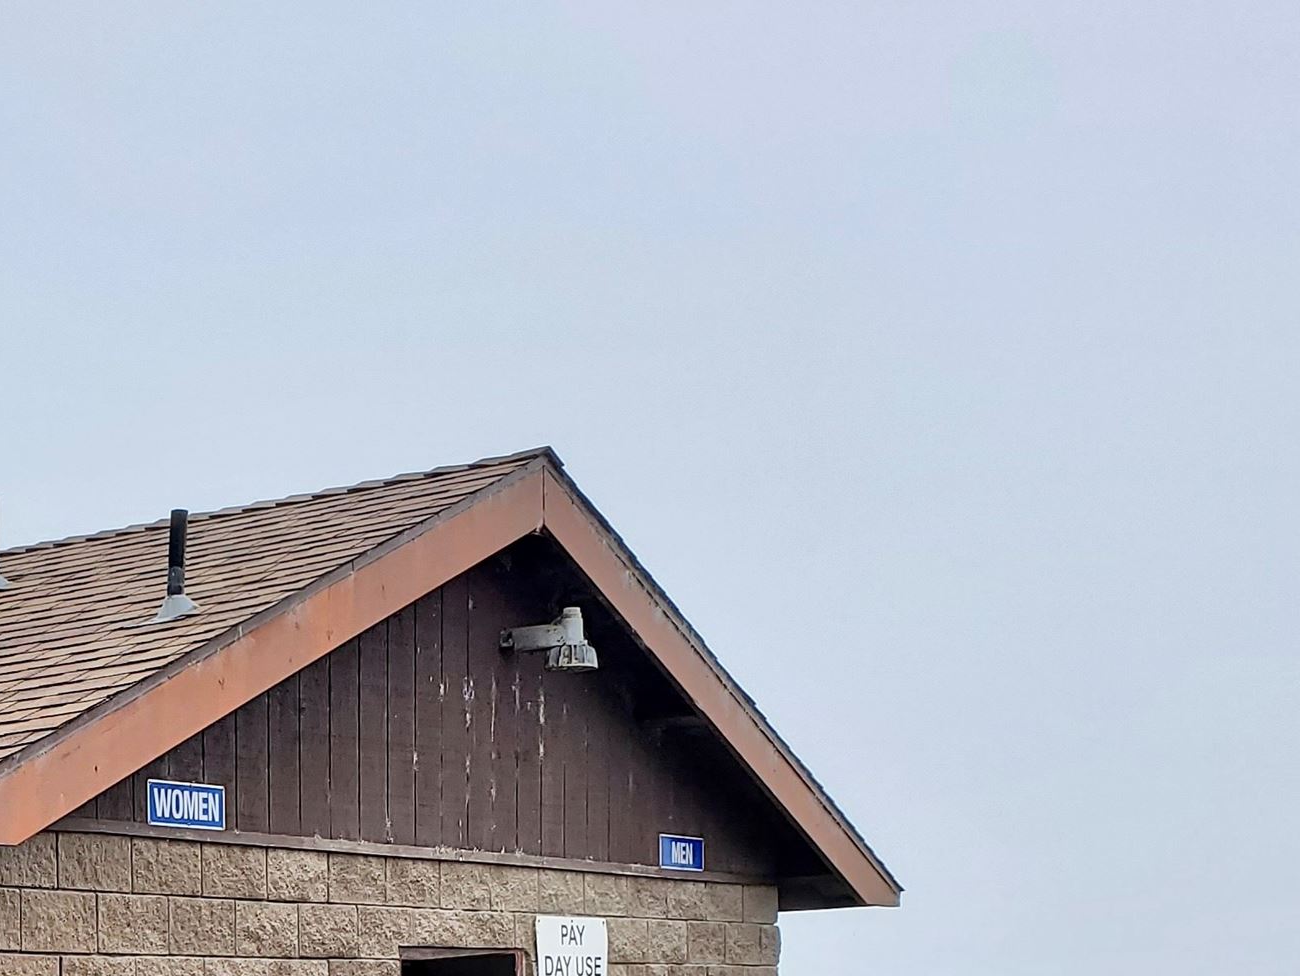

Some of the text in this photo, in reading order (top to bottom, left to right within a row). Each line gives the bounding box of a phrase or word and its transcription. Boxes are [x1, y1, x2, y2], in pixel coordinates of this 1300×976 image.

[153, 787, 220, 822] WOMEN
[671, 840, 693, 865] MEN
[560, 924, 585, 945] PAY
[544, 956, 602, 976] DAY USE
